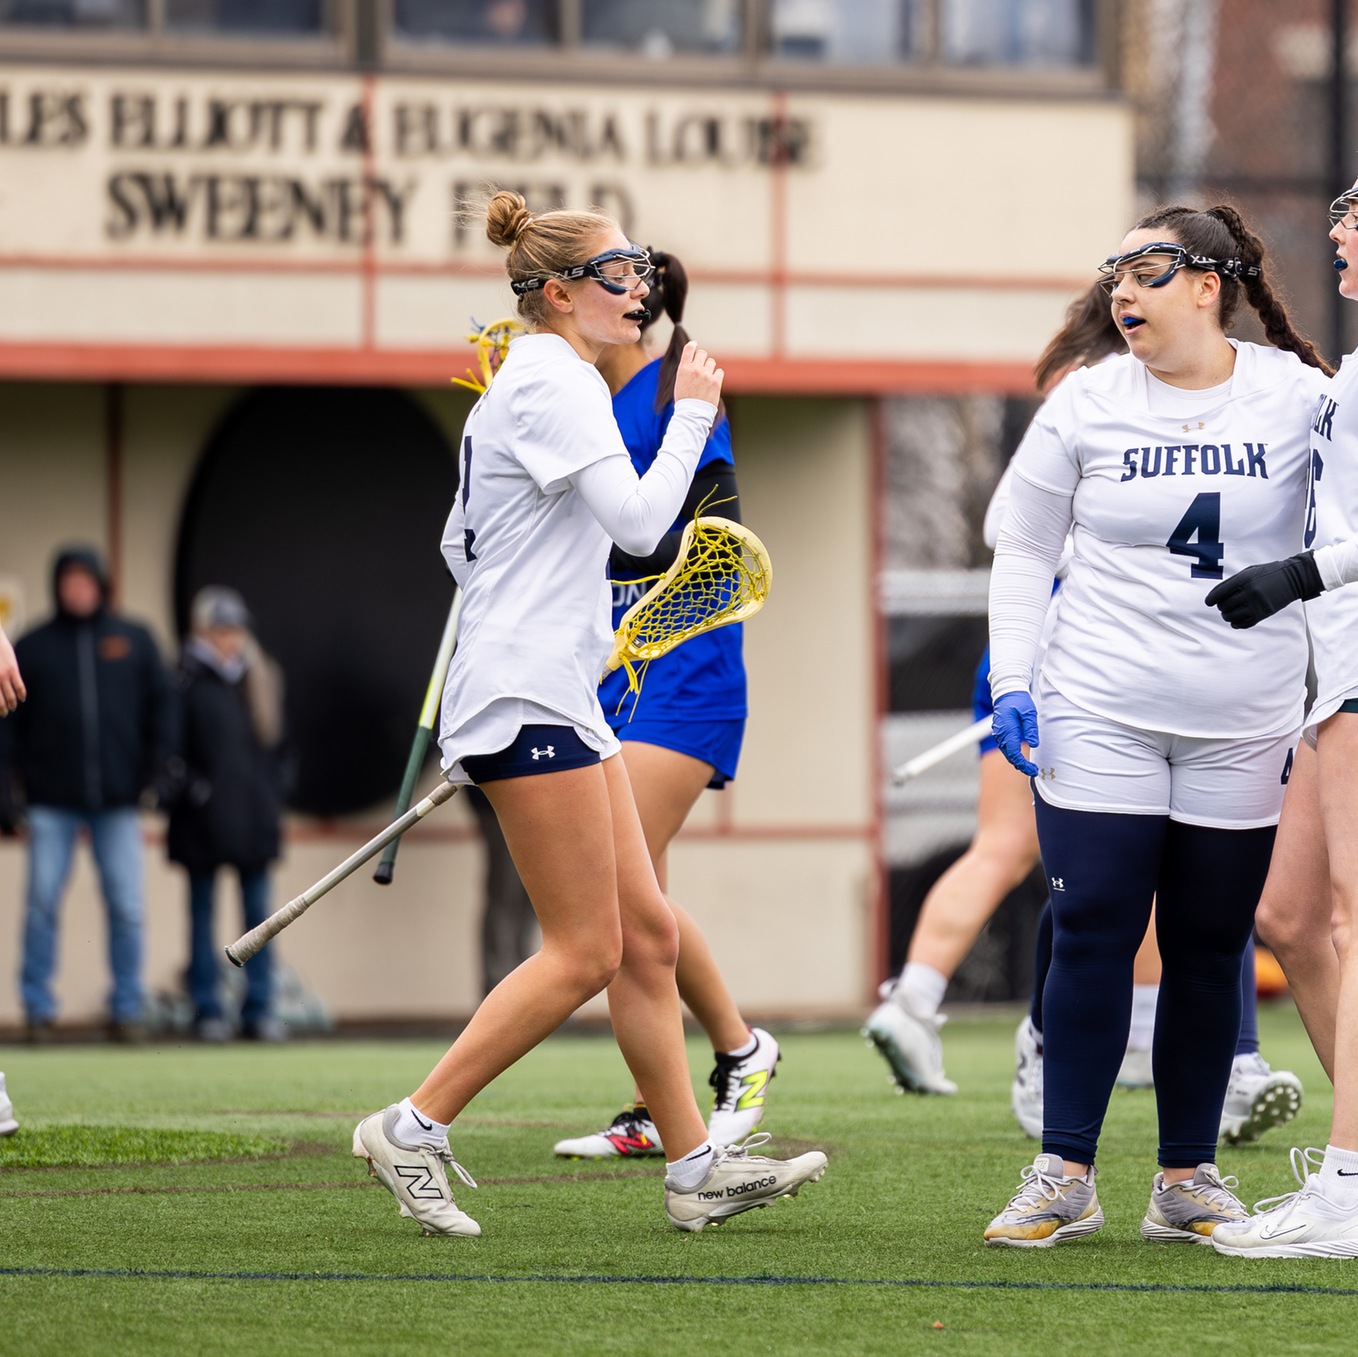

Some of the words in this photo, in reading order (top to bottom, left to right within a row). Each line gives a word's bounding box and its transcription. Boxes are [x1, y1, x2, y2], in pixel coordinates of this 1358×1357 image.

[1121, 443, 1269, 482] SUFFOLK
[1166, 492, 1224, 580] 4
[394, 1165, 444, 1200] N
[698, 1190, 724, 1200] new
[726, 1175, 777, 1197] balance
